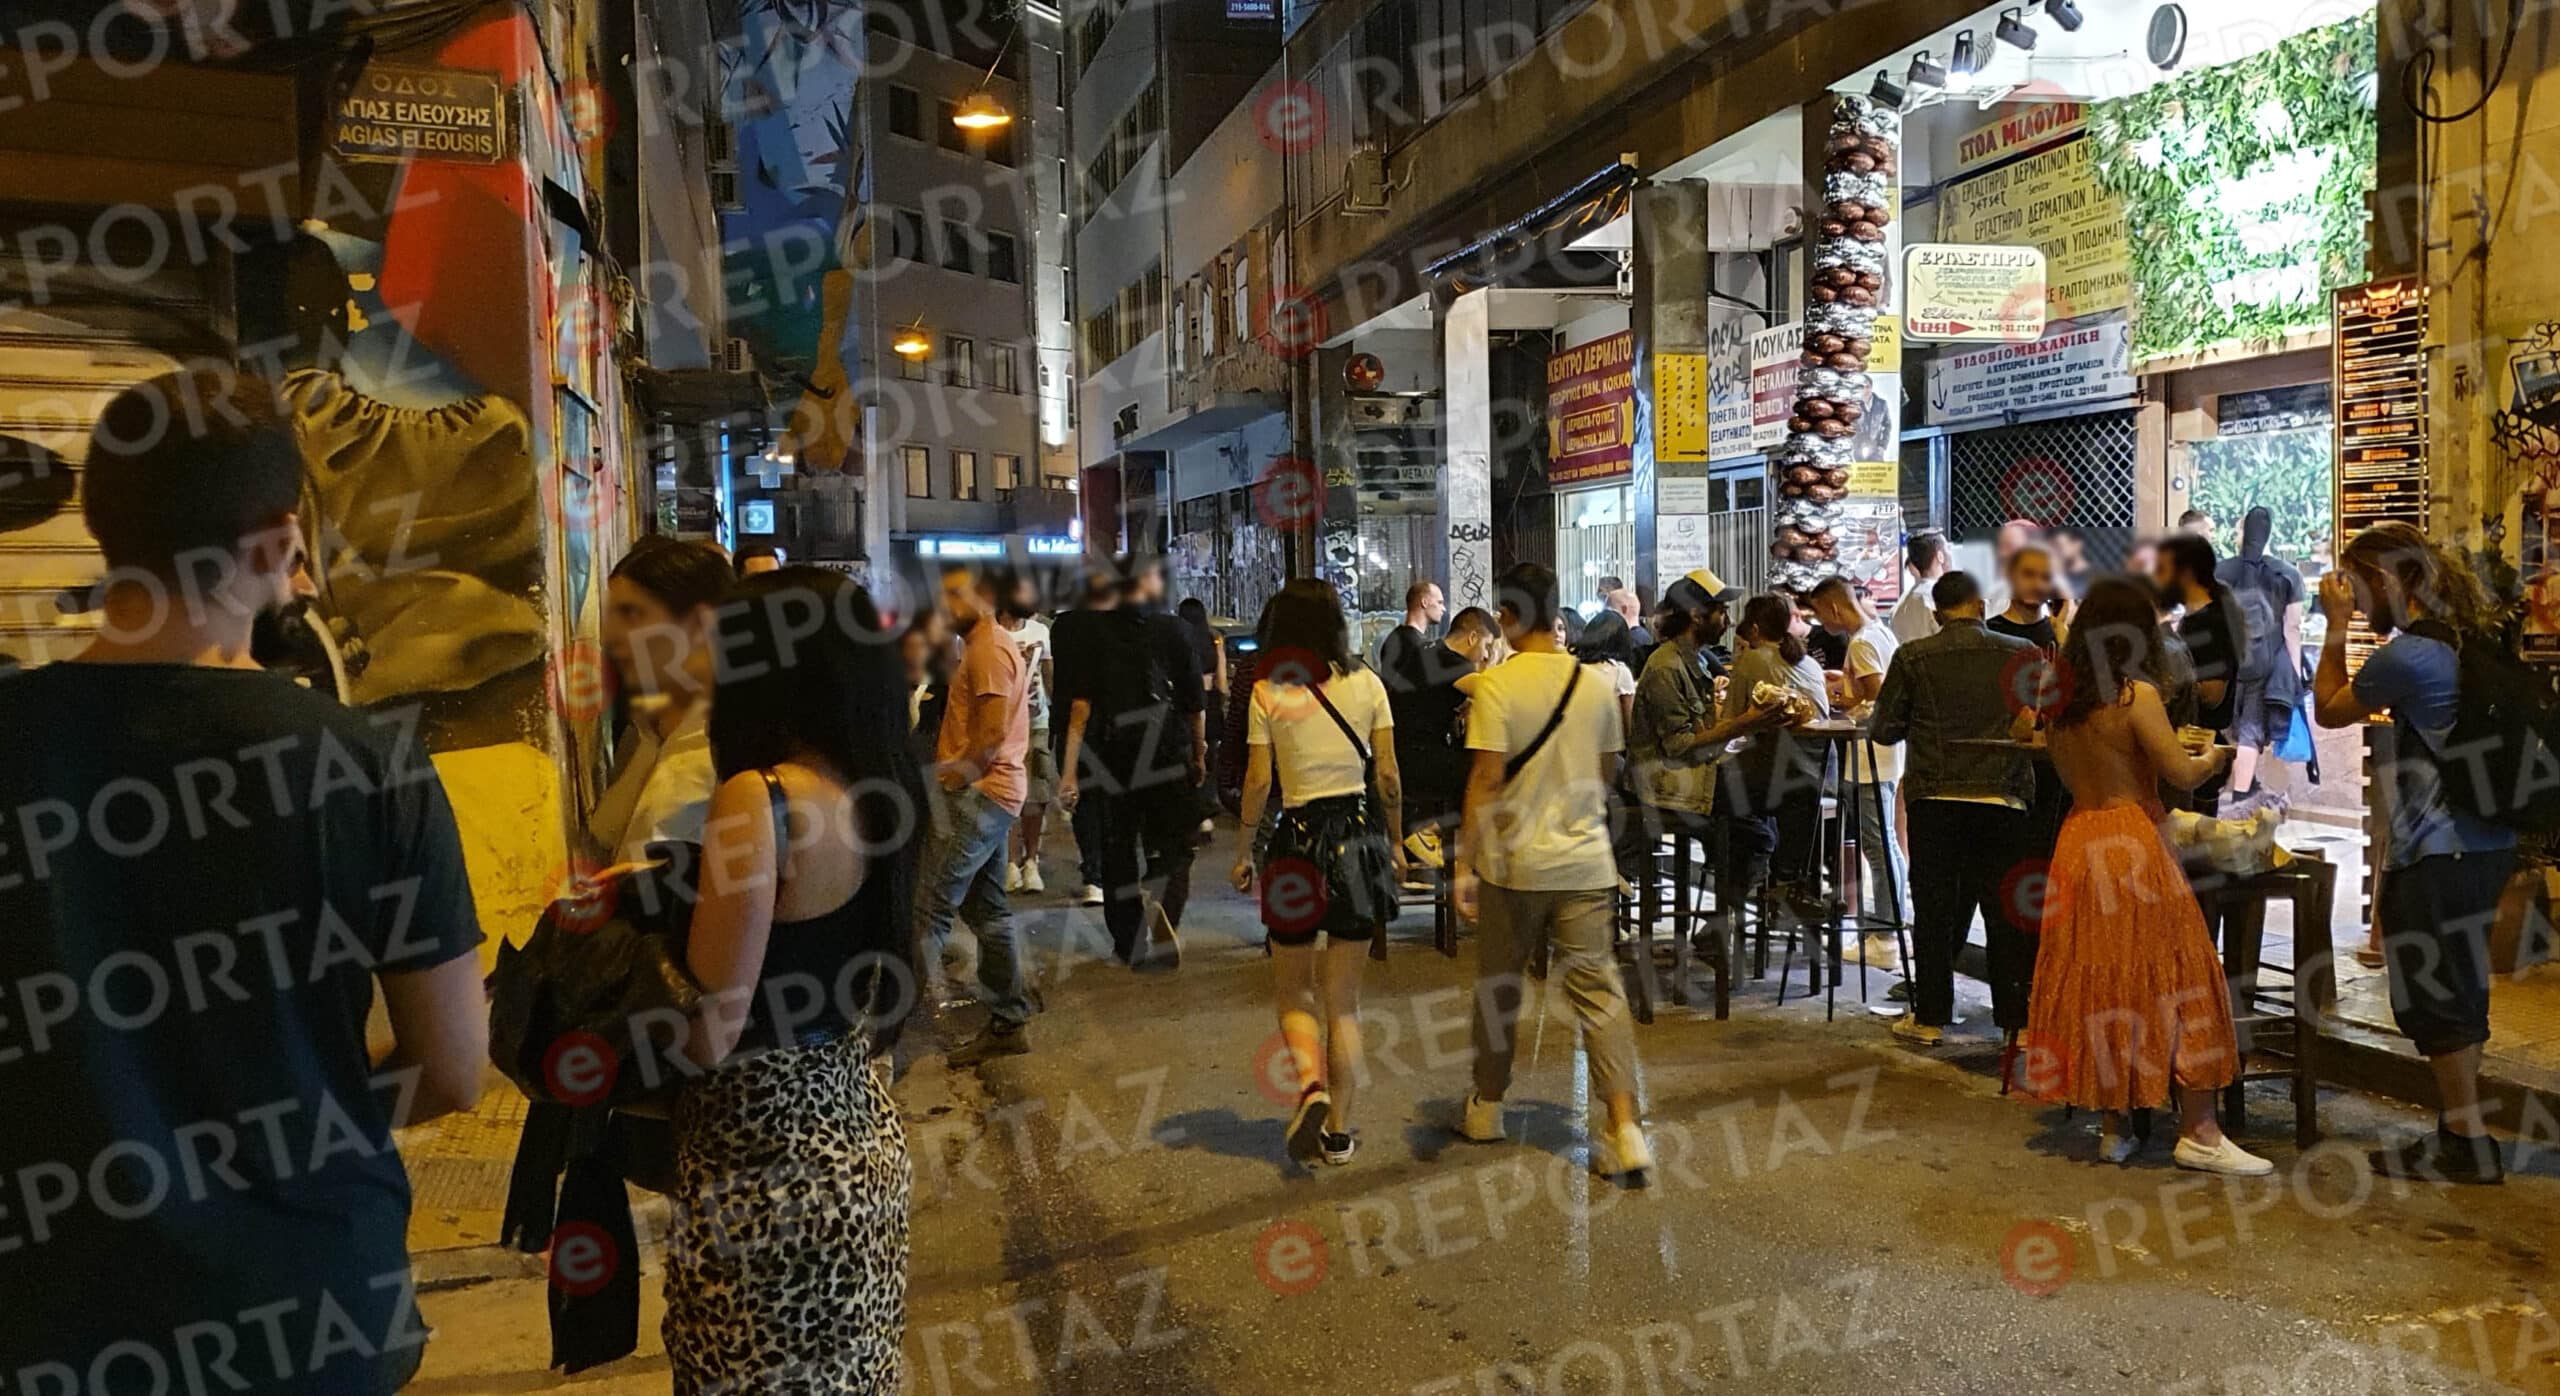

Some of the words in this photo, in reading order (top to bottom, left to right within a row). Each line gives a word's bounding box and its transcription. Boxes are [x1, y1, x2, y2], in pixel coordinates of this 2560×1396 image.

[395, 101, 492, 127] ΕΛΕΟΥΣΗΣ
[338, 124, 399, 147] AGIAS
[402, 128, 494, 154] ELEOUSIS
[1959, 129, 1998, 164] ΣΤΟΑ
[2013, 148, 2070, 186] ΔΕΡΜΑΤΙΝΩΝ
[2028, 188, 2086, 225] ΔΕΡΜΑΤΙΝΩΝ
[1753, 327, 1803, 360] ΛΟΥΚΑΣ
[1548, 350, 1583, 384] ΚΕΝΤΡΟ
